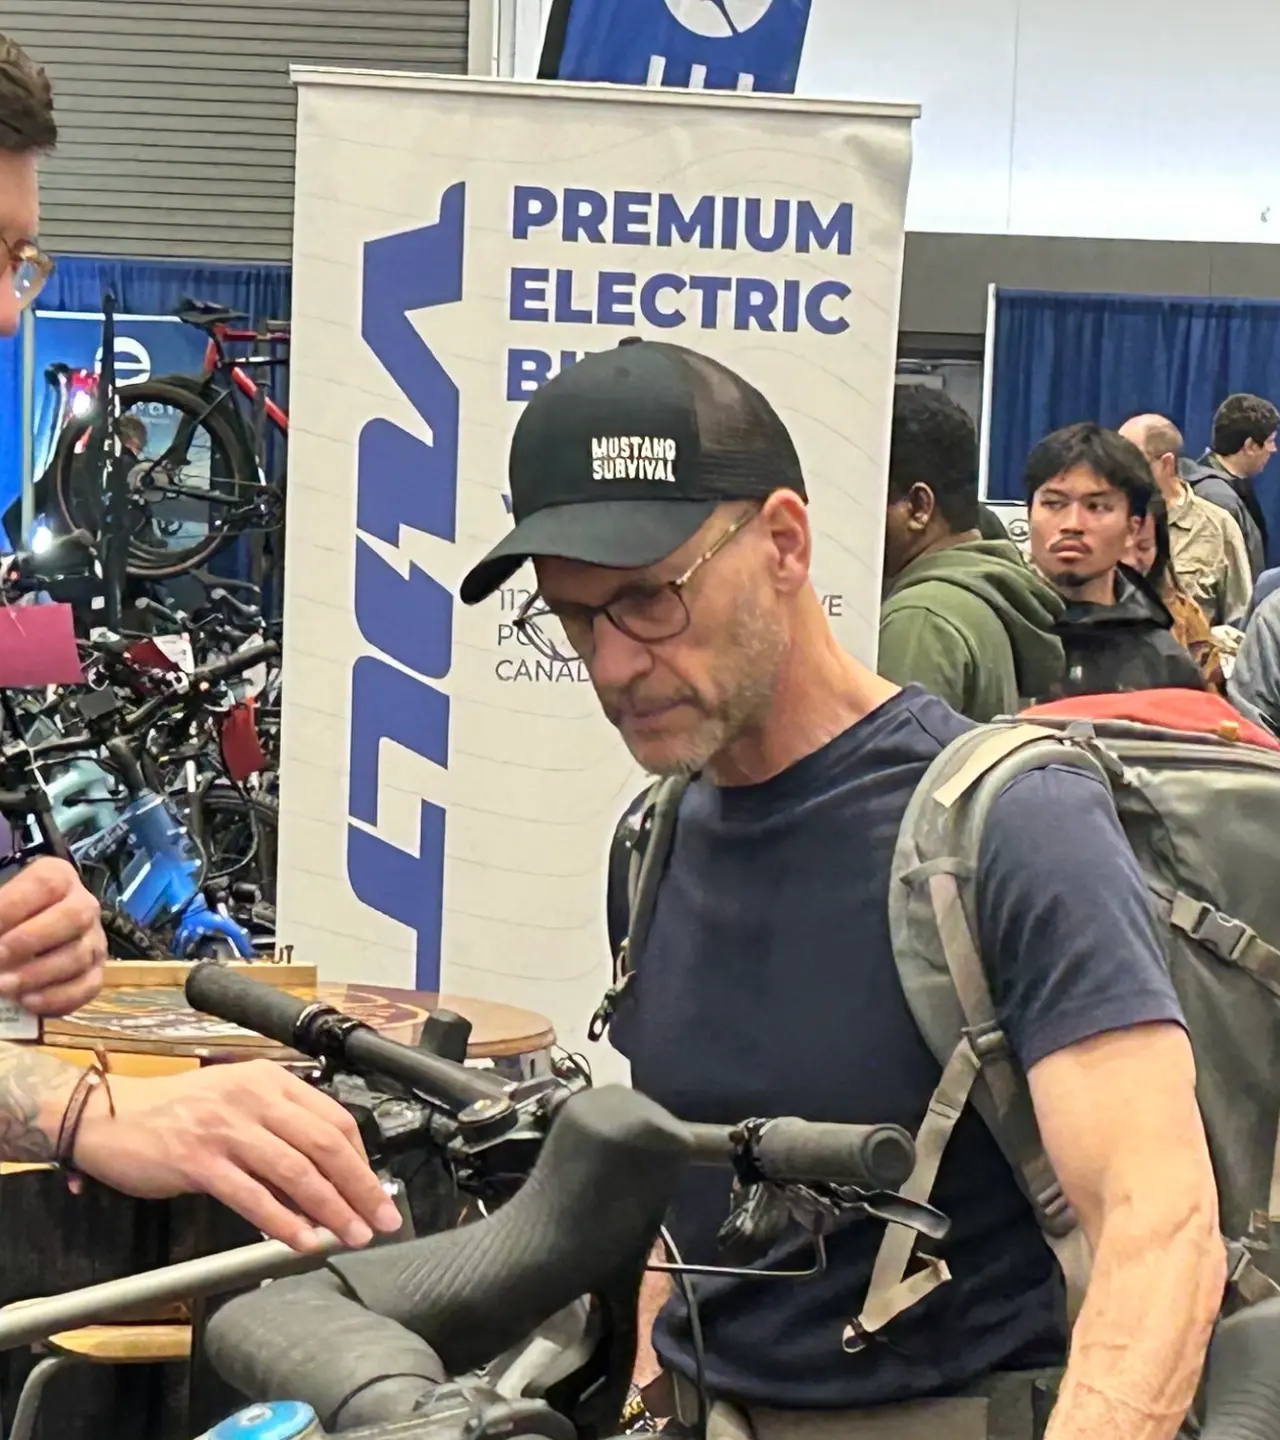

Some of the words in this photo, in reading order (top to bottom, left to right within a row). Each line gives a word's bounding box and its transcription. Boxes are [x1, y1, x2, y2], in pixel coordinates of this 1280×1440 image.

[512, 185, 854, 256] PREMIUM
[509, 267, 852, 335] ELECTRIC
[592, 458, 676, 482] SURVIVAL
